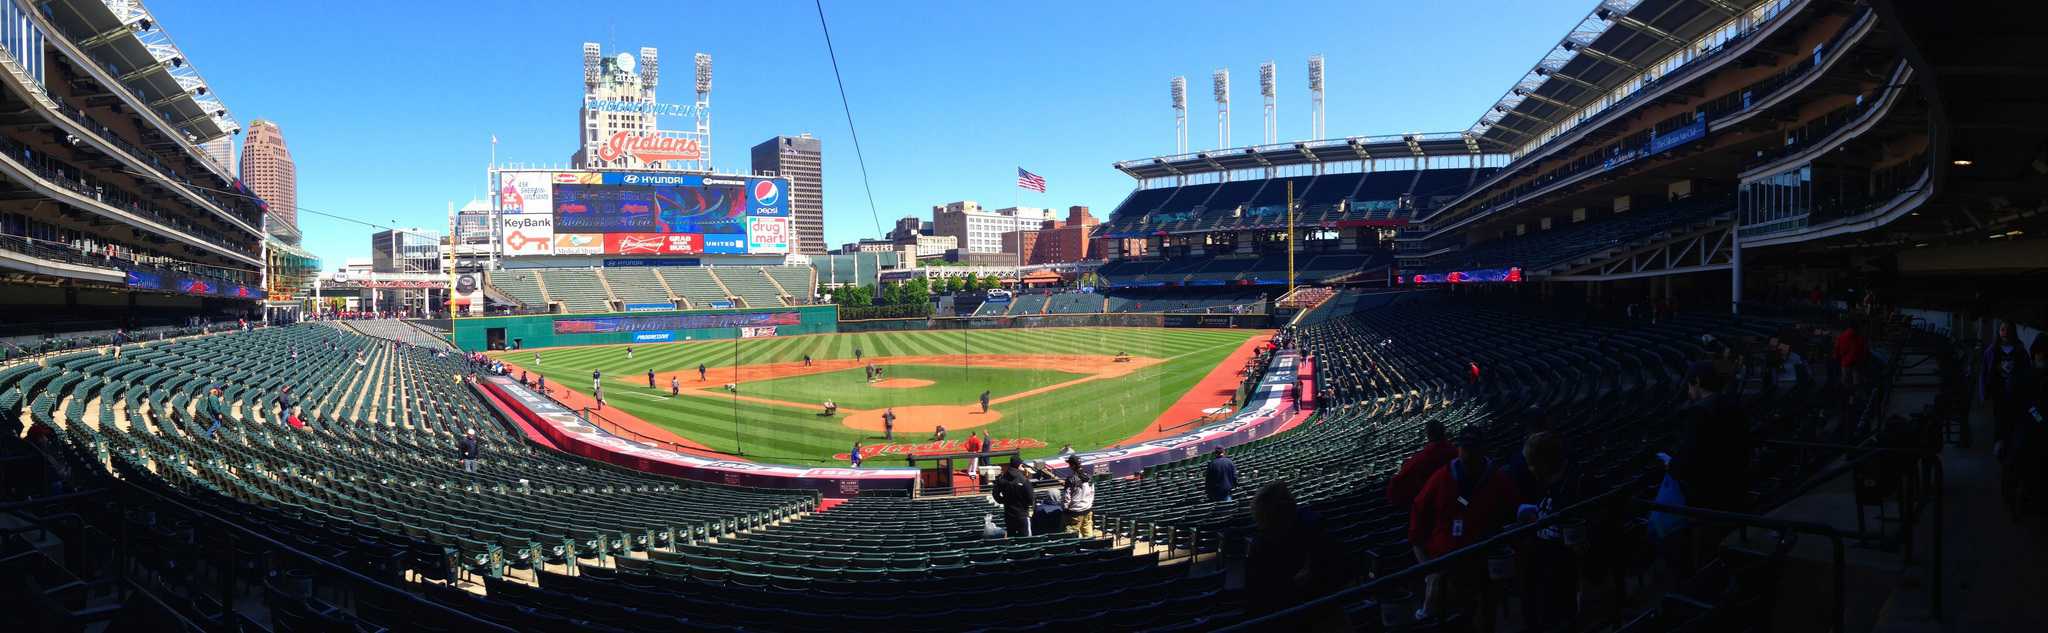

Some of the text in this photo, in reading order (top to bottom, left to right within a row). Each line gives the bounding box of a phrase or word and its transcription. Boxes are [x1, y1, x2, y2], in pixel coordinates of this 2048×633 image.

[599, 130, 700, 163] Indians
[641, 175, 684, 185] HYUNDAI
[756, 207, 778, 215] pepsi
[504, 218, 551, 229] KeyBank
[752, 217, 780, 233] drug
[755, 232, 785, 244] mart
